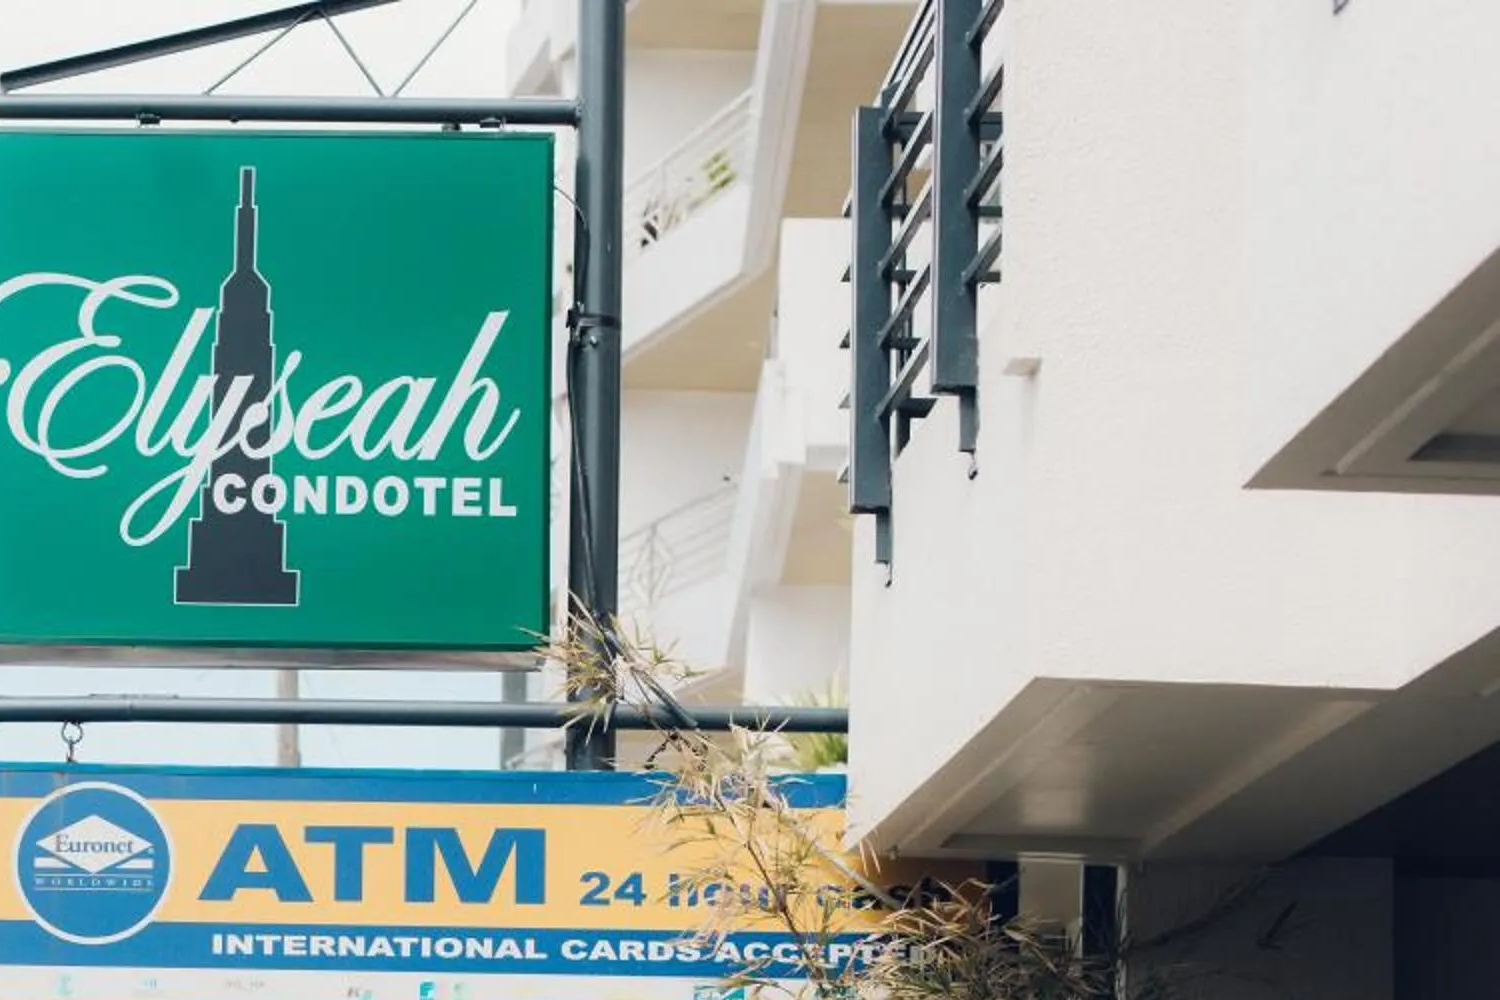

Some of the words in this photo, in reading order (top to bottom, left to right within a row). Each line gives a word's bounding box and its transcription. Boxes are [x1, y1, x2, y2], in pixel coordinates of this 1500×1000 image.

[212, 473, 518, 518] CONDOTEL
[54, 834, 135, 854] Euronet
[198, 823, 547, 905] ATM
[579, 871, 647, 907] 24
[211, 933, 549, 960] INTERNATIONAL
[560, 939, 702, 963] CARDS
